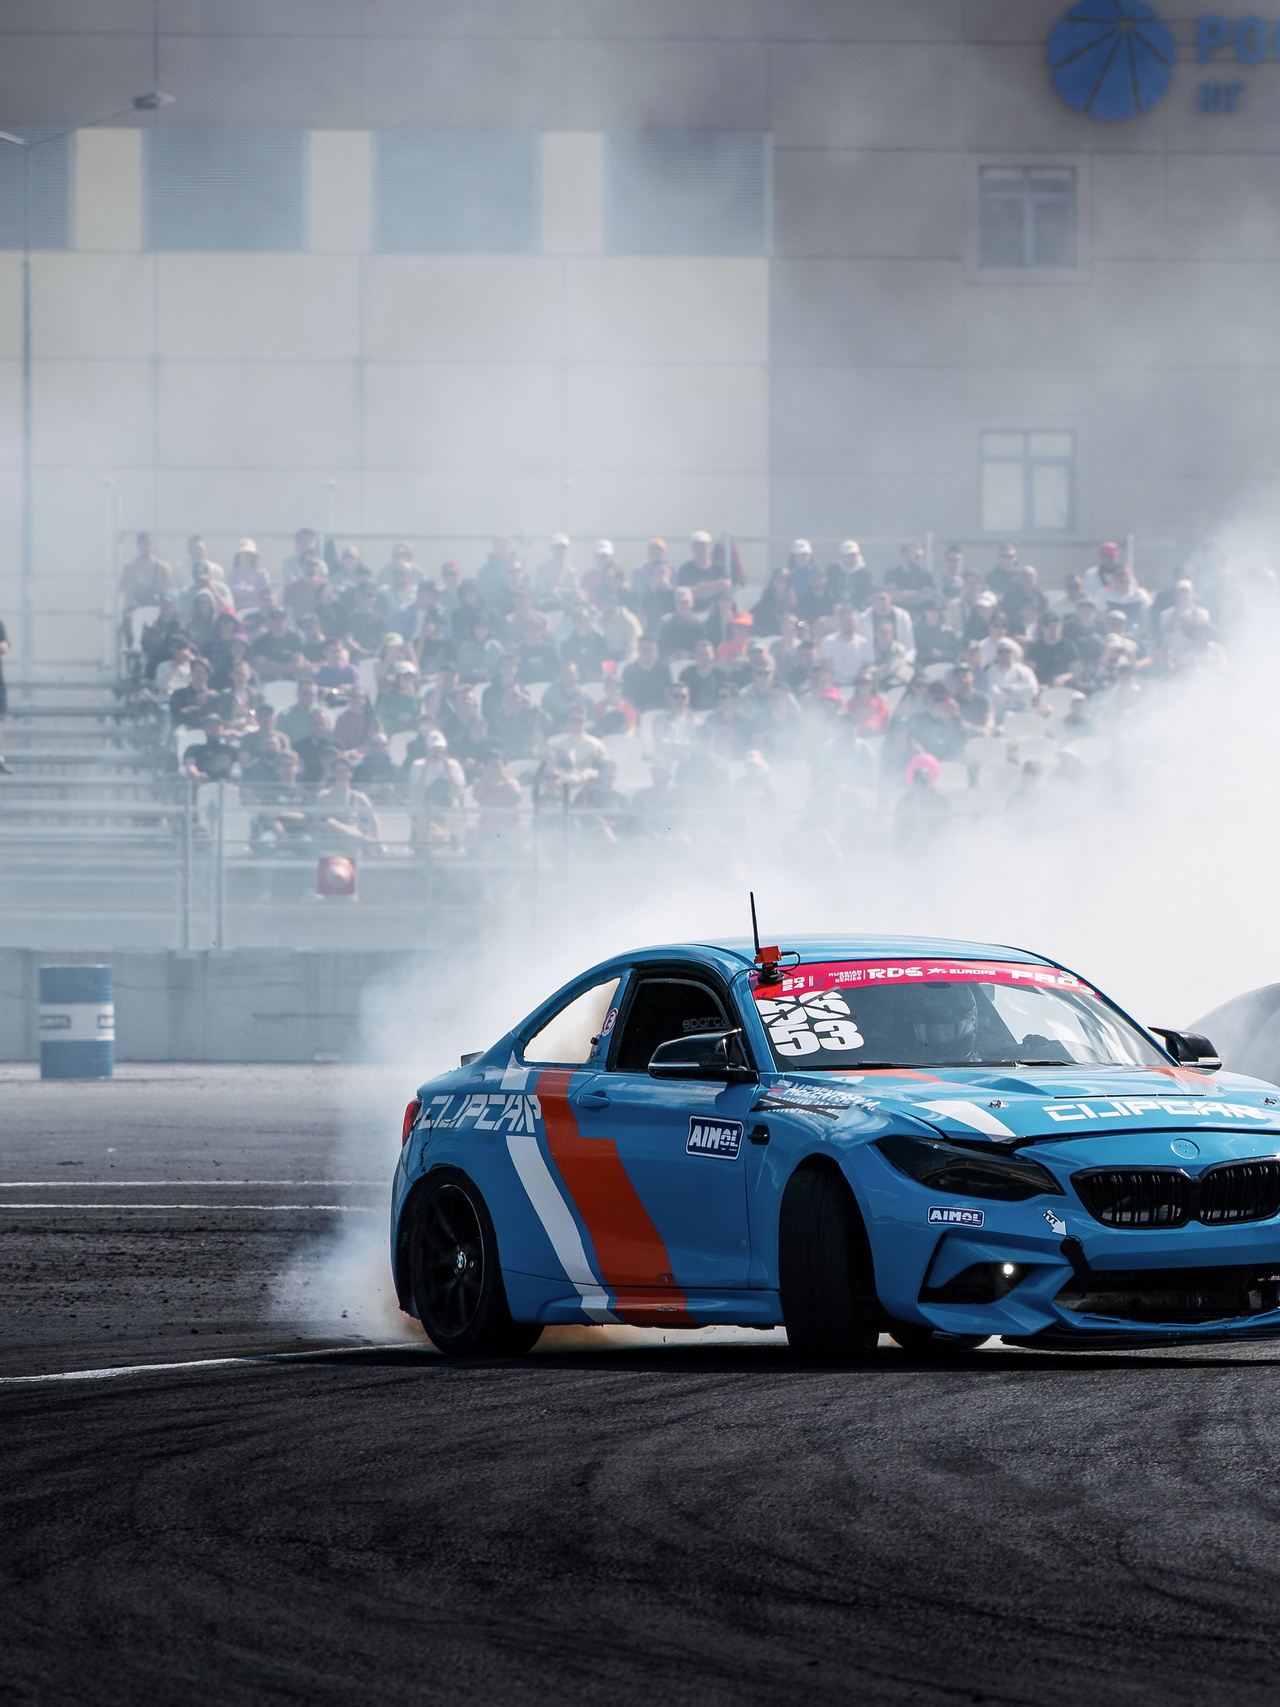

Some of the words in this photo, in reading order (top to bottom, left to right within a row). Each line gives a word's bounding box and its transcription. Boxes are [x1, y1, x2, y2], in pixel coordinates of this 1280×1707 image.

[1198, 82, 1247, 113] ЮГ
[868, 966, 923, 979] RDS
[949, 968, 996, 976] EUROPE
[1011, 970, 1079, 987] PRO
[768, 1020, 865, 1056] 53
[418, 1094, 542, 1133] CLIPCAR
[1041, 1100, 1268, 1122] CLIPCAR
[688, 1125, 738, 1151] AIMOL
[930, 1209, 981, 1224] AIMOL
